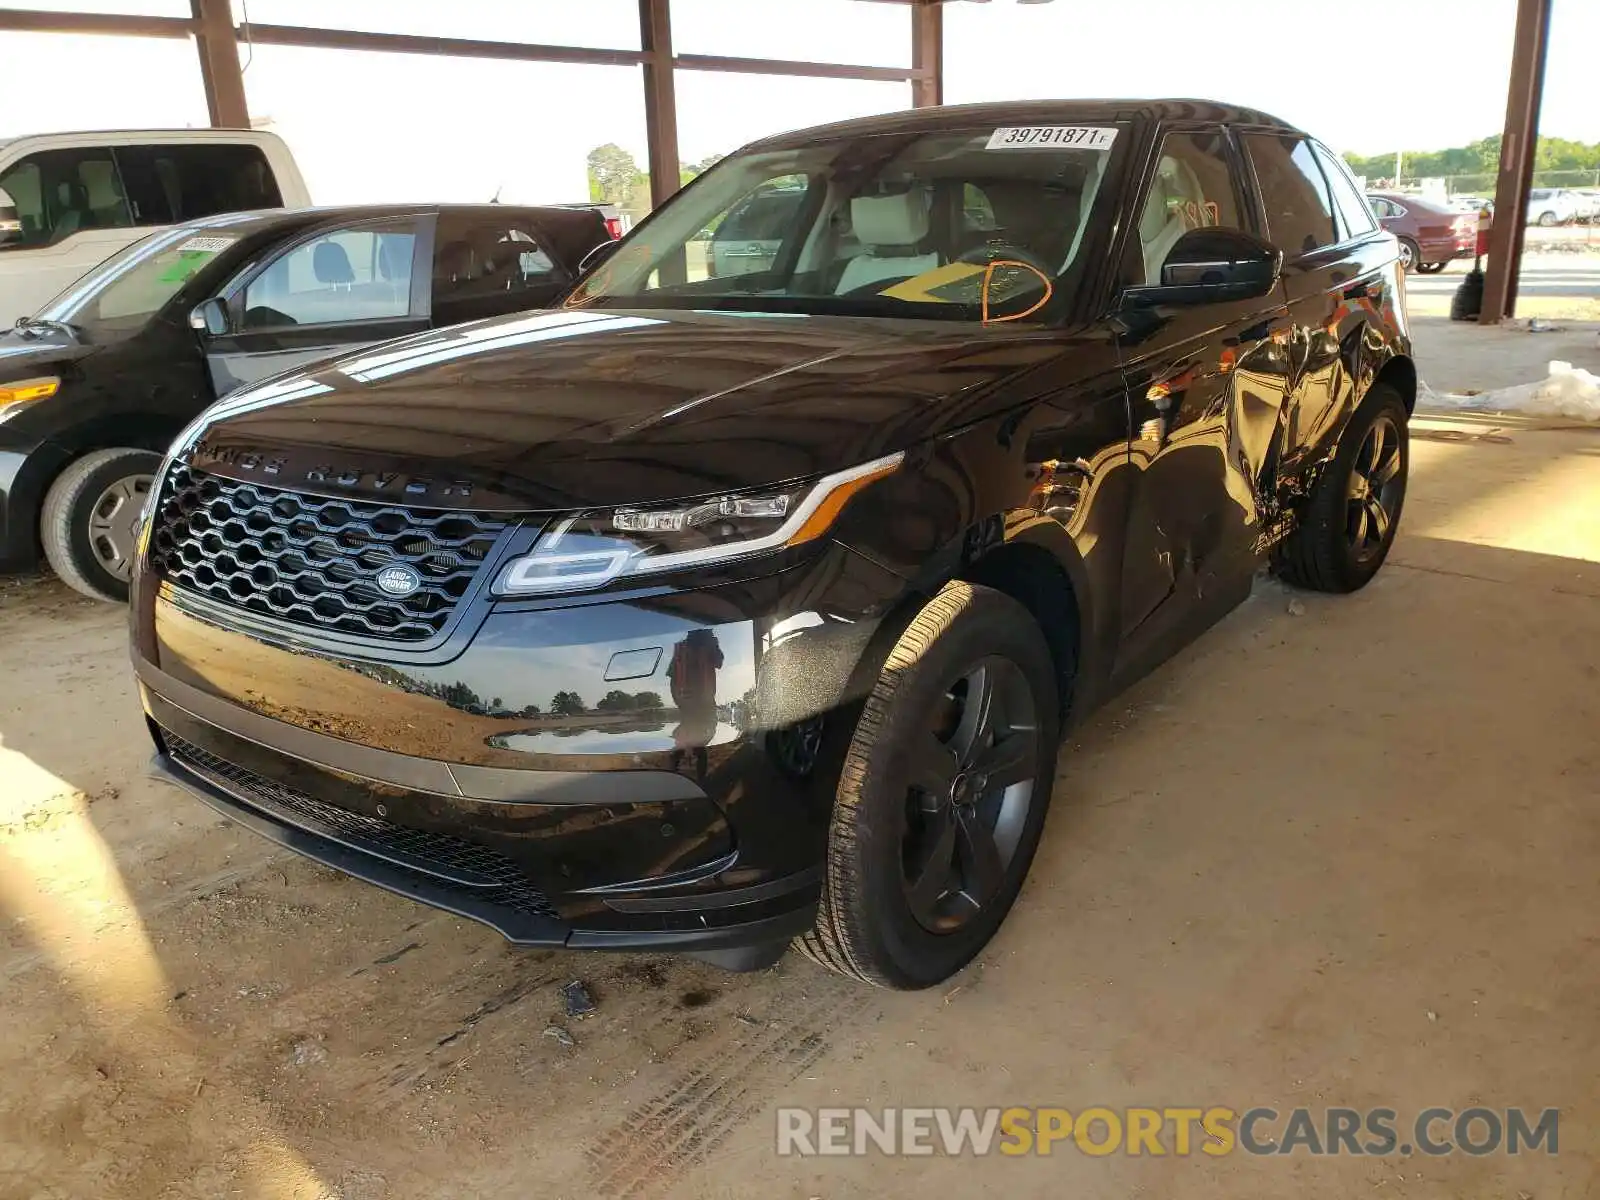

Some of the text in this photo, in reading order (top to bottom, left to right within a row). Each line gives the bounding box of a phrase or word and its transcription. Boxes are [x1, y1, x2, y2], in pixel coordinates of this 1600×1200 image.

[1005, 128, 1098, 145] 39791871
[306, 463, 474, 496] ROVER
[385, 571, 407, 581] LAND
[385, 579, 411, 591] ROVER
